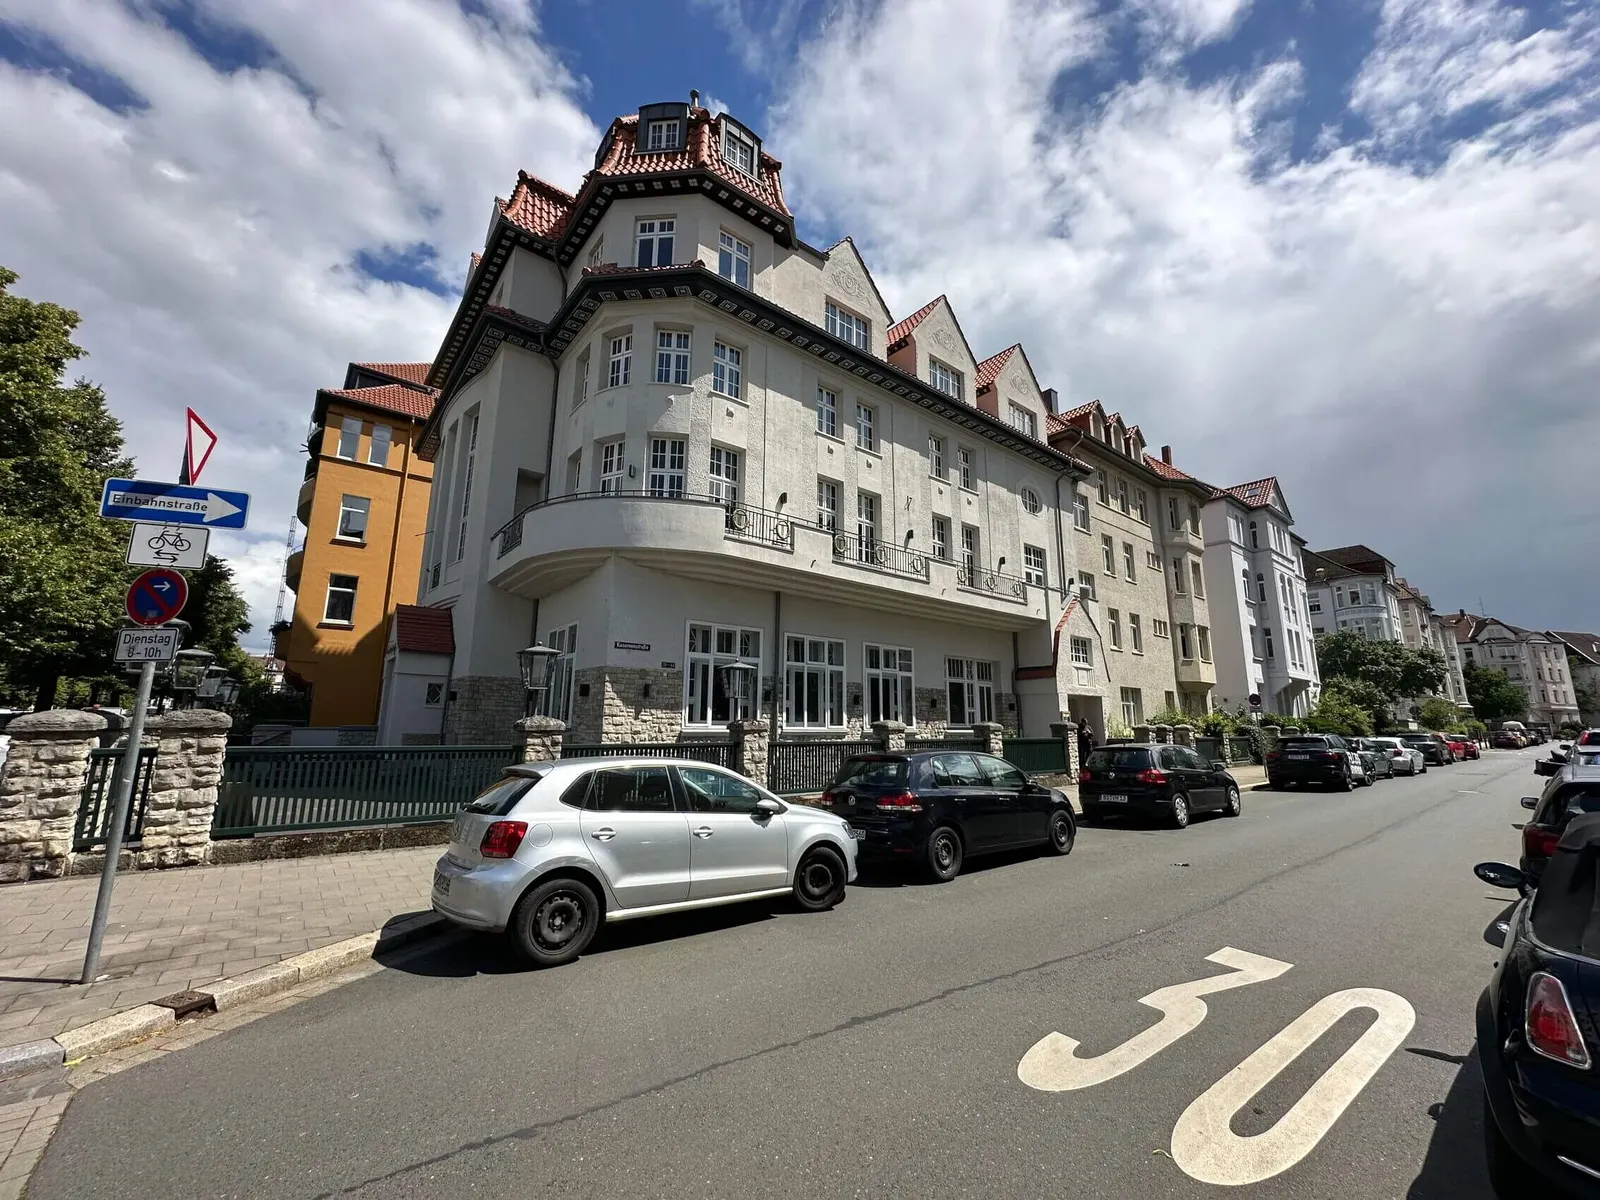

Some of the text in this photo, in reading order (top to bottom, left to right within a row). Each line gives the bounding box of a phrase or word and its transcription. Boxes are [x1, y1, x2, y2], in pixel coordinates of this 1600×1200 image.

[112, 494, 208, 511] Einbahnstraße
[123, 633, 171, 646] Dienstag
[1017, 946, 1416, 1185] 30
